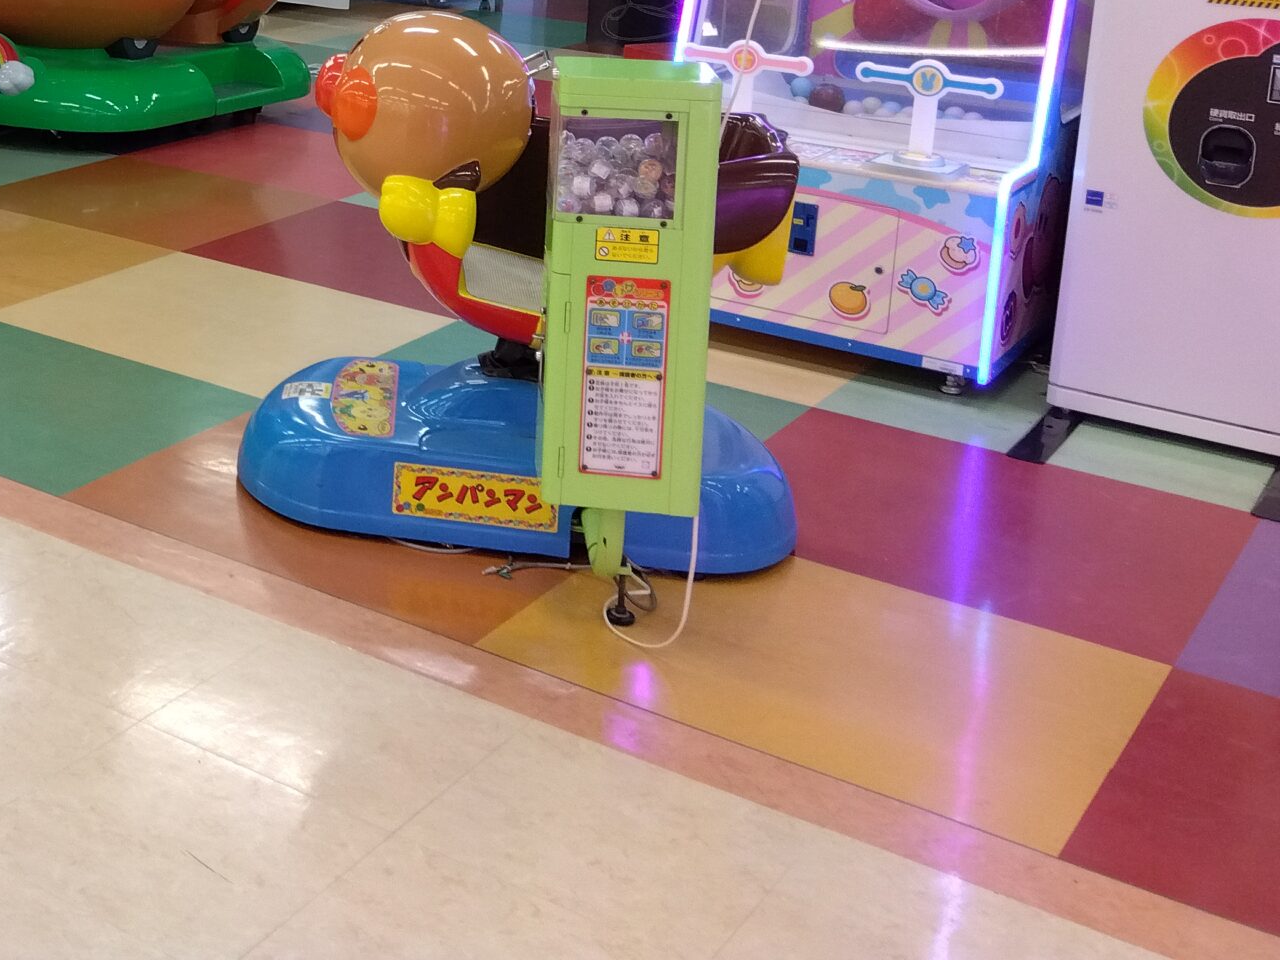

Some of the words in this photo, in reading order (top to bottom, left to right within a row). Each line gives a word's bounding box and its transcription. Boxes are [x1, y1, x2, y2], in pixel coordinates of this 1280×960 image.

[412, 476, 542, 514] アンパンマン
